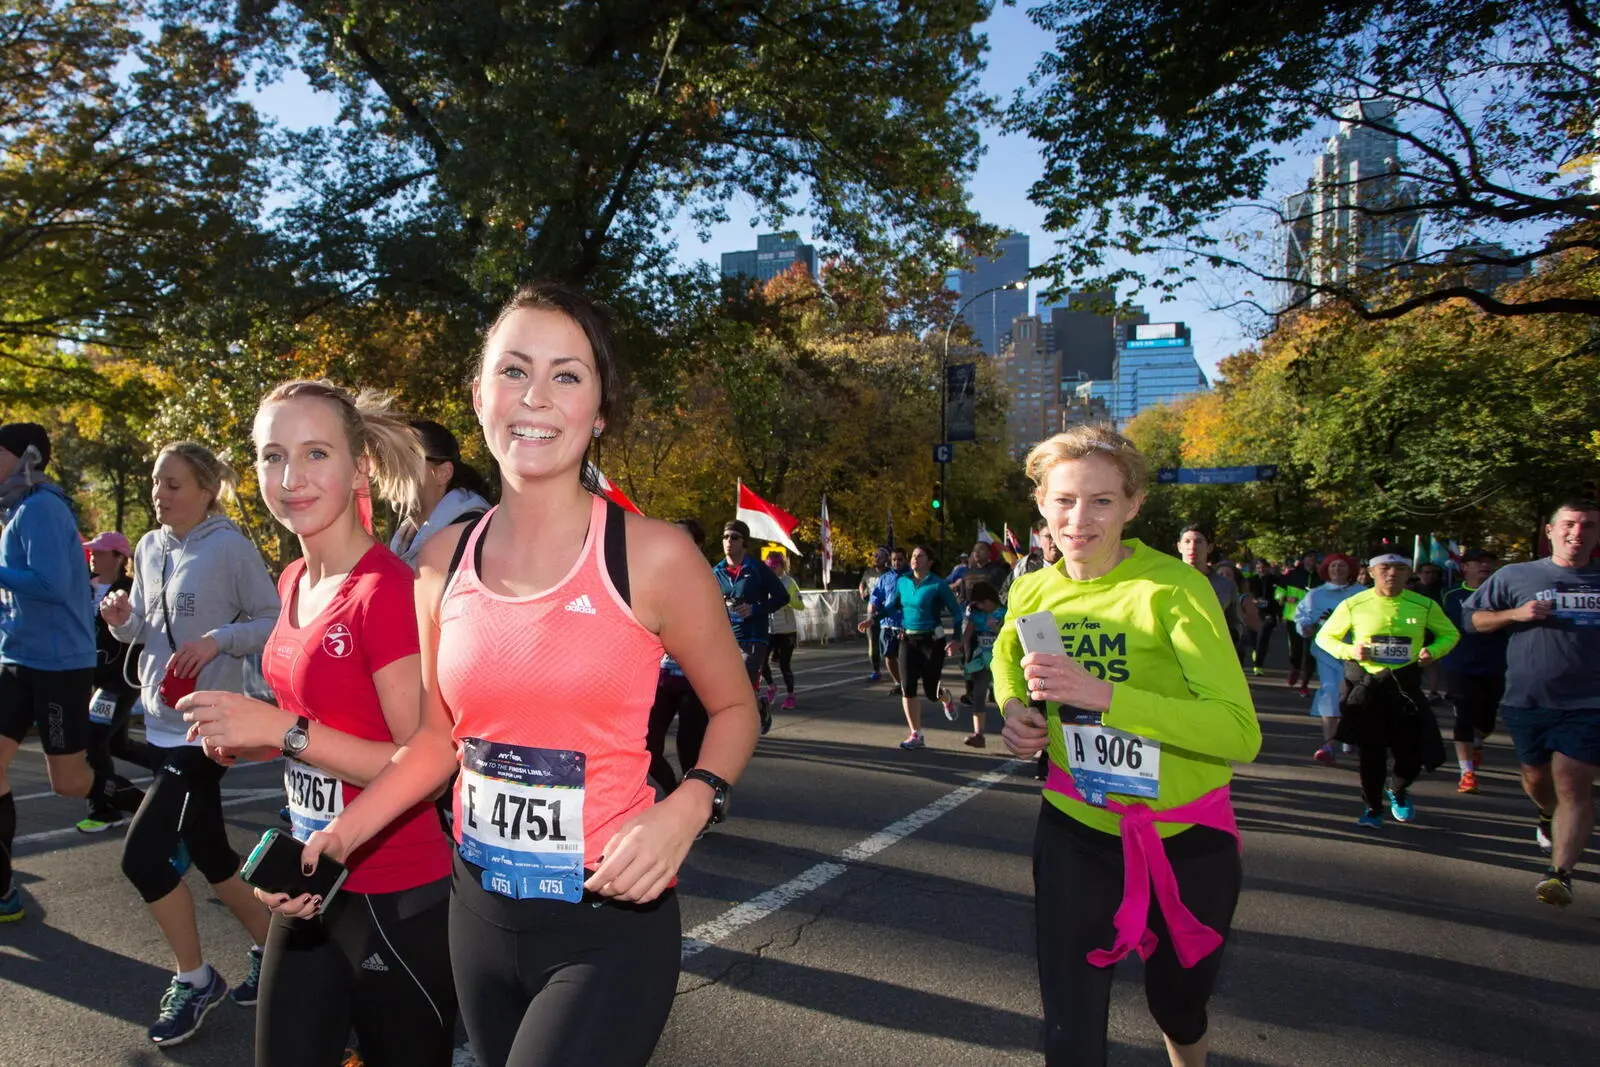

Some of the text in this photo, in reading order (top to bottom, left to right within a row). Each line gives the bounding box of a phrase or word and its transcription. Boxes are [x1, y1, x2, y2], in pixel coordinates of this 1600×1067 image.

[937, 447, 948, 460] C
[1561, 596, 1569, 609] L
[564, 604, 596, 615] adidas
[1061, 633, 1127, 657] EAM
[1374, 645, 1380, 656] E
[1073, 732, 1144, 770] A 906
[508, 766, 527, 774] FINISH
[468, 783, 567, 841] E 4751
[491, 876, 512, 895] 4751
[539, 879, 565, 895] 4751
[361, 962, 389, 972] adidas
